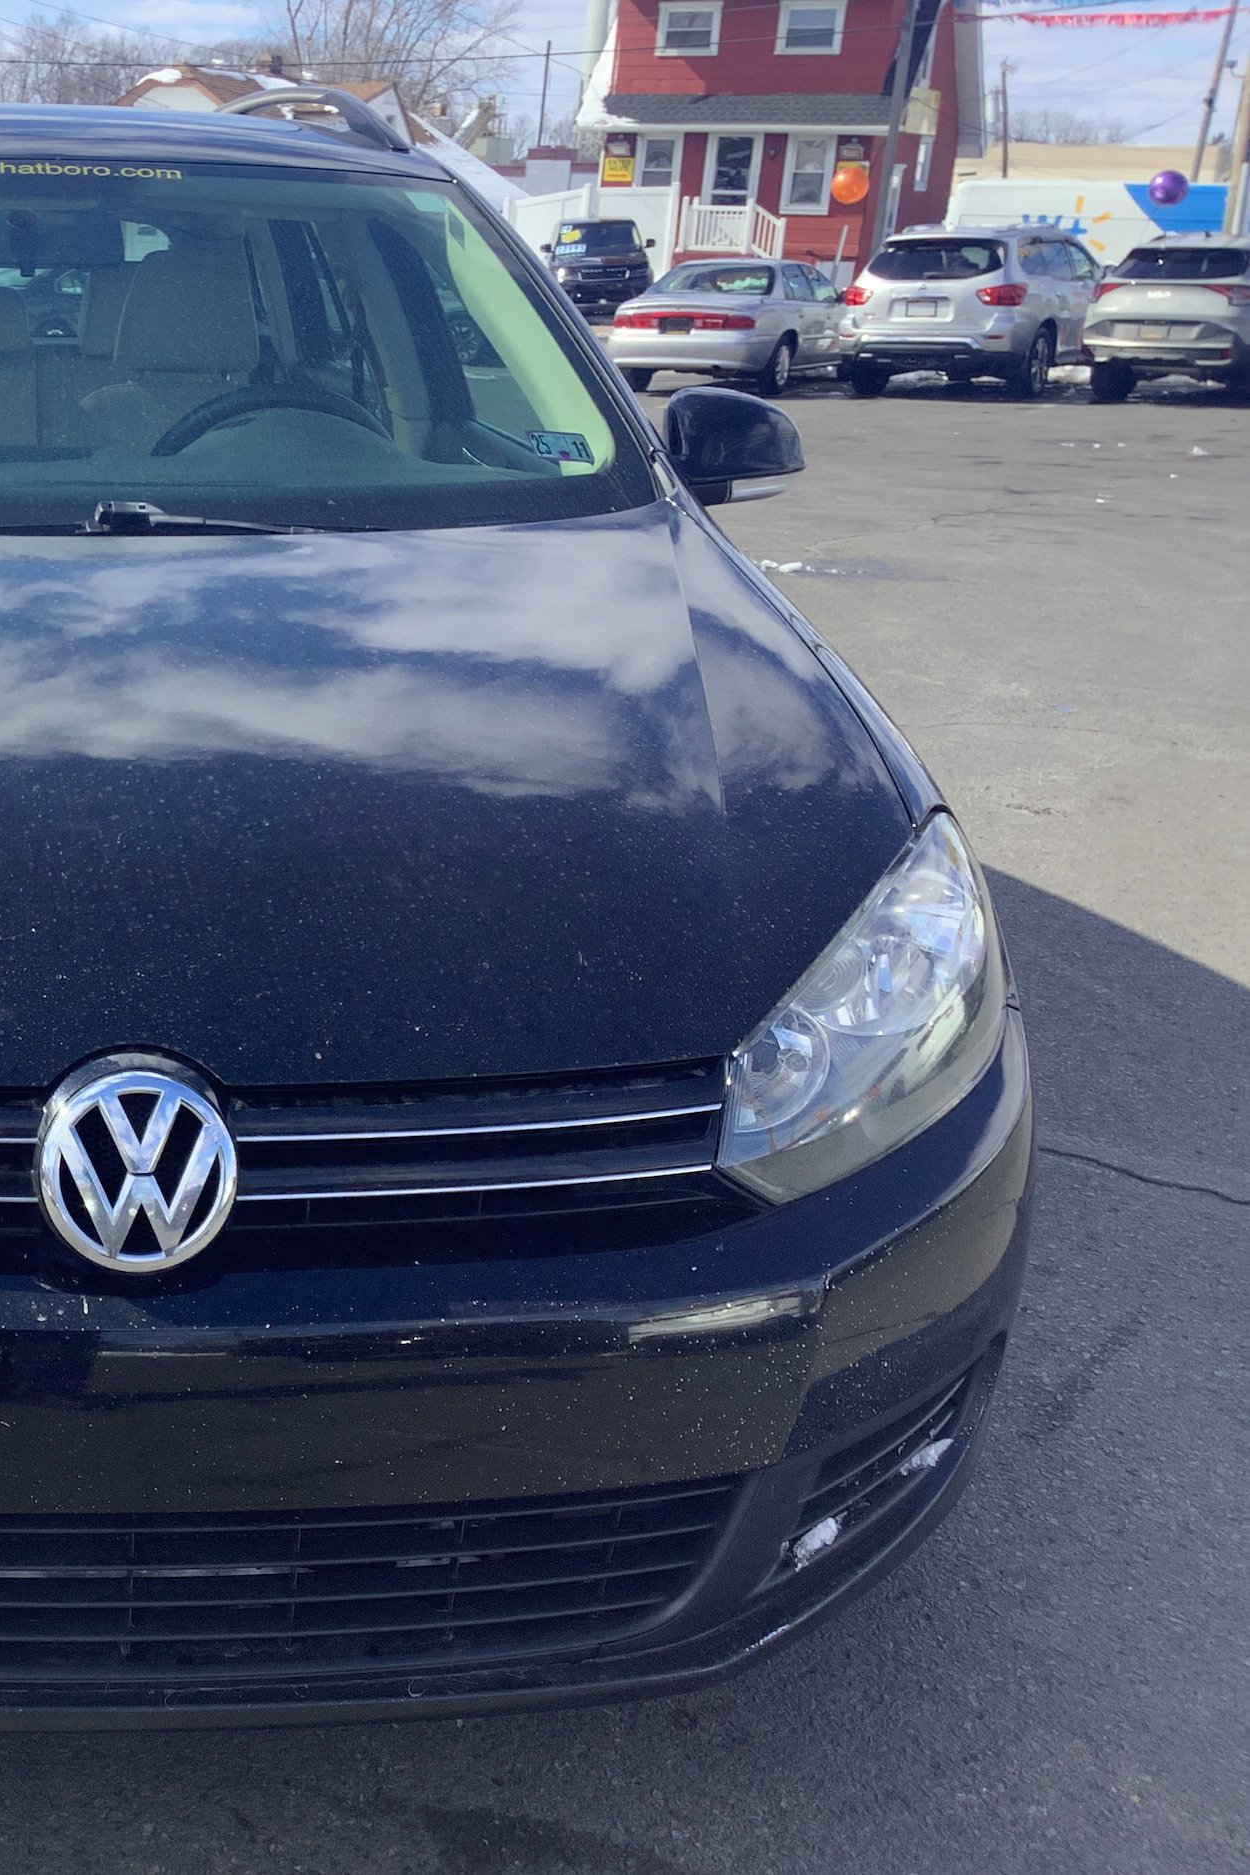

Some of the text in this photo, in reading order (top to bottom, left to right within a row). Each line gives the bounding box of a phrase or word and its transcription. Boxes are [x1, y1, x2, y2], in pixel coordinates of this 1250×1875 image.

[531, 434, 590, 459] 25 11
[39, 1071, 237, 1273] VW
